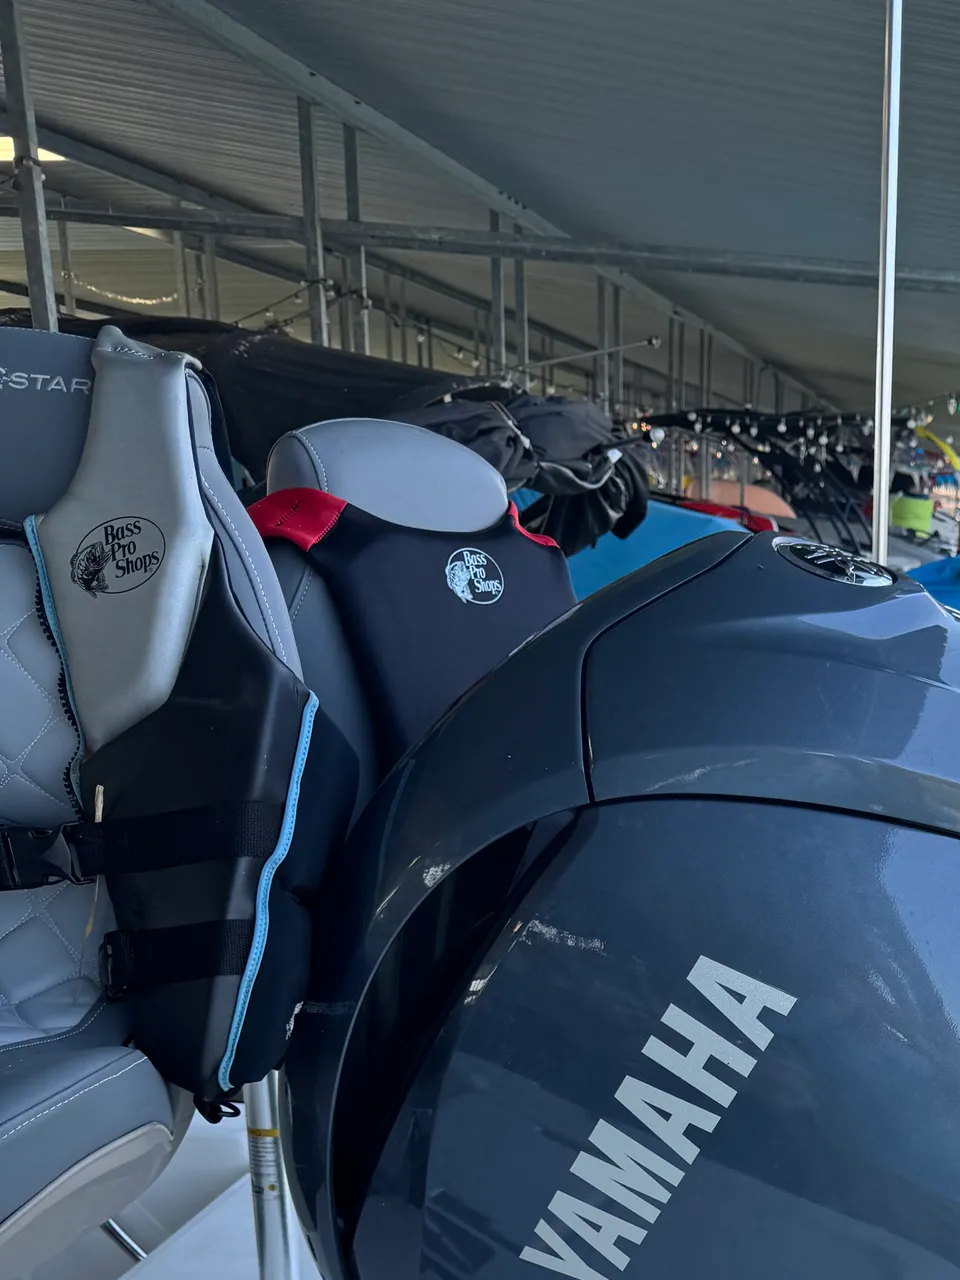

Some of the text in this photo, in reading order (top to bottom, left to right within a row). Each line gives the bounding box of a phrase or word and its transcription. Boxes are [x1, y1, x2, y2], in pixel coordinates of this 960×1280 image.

[0, 367, 92, 395] STAR
[104, 520, 142, 546] Bass
[110, 541, 137, 562] Pro
[463, 551, 487, 567] Bass
[115, 551, 160, 579] Shops
[470, 565, 486, 579] Pro
[474, 578, 501, 595] Shops
